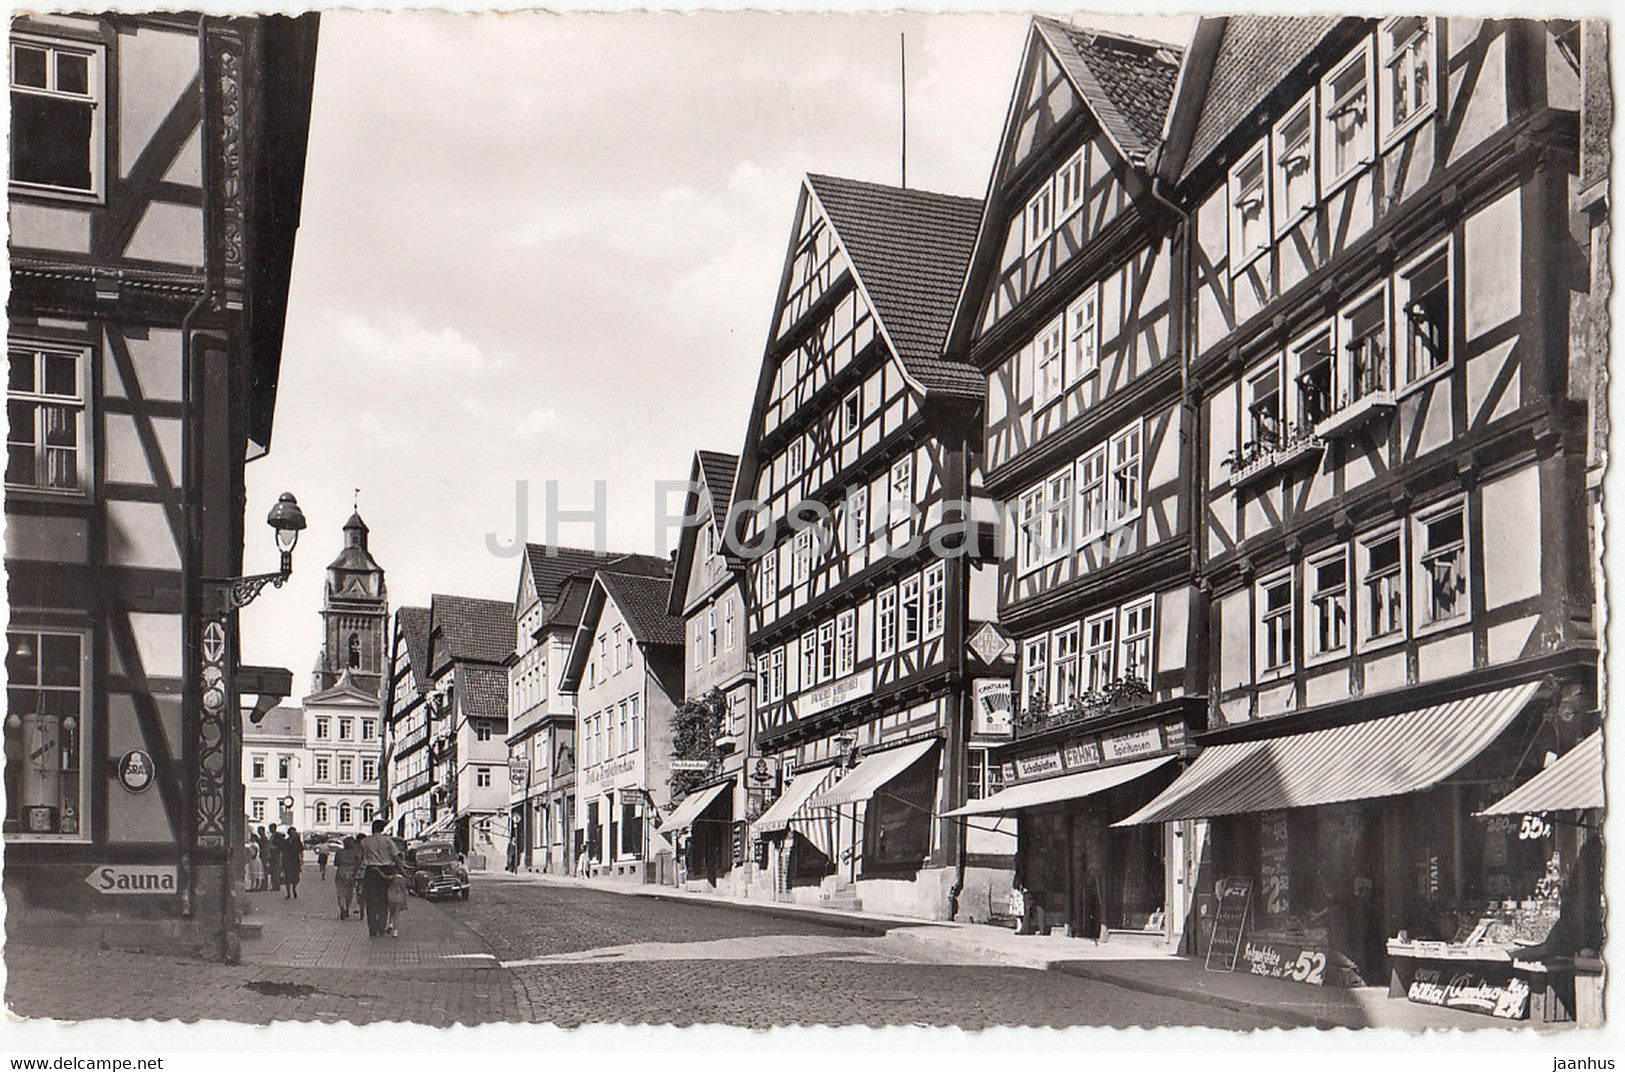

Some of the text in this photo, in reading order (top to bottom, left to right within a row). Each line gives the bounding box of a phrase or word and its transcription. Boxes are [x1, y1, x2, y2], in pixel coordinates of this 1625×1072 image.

[1113, 741, 1151, 756] Spirituosen
[100, 868, 175, 890] Sauna
[1292, 951, 1327, 985] 52
